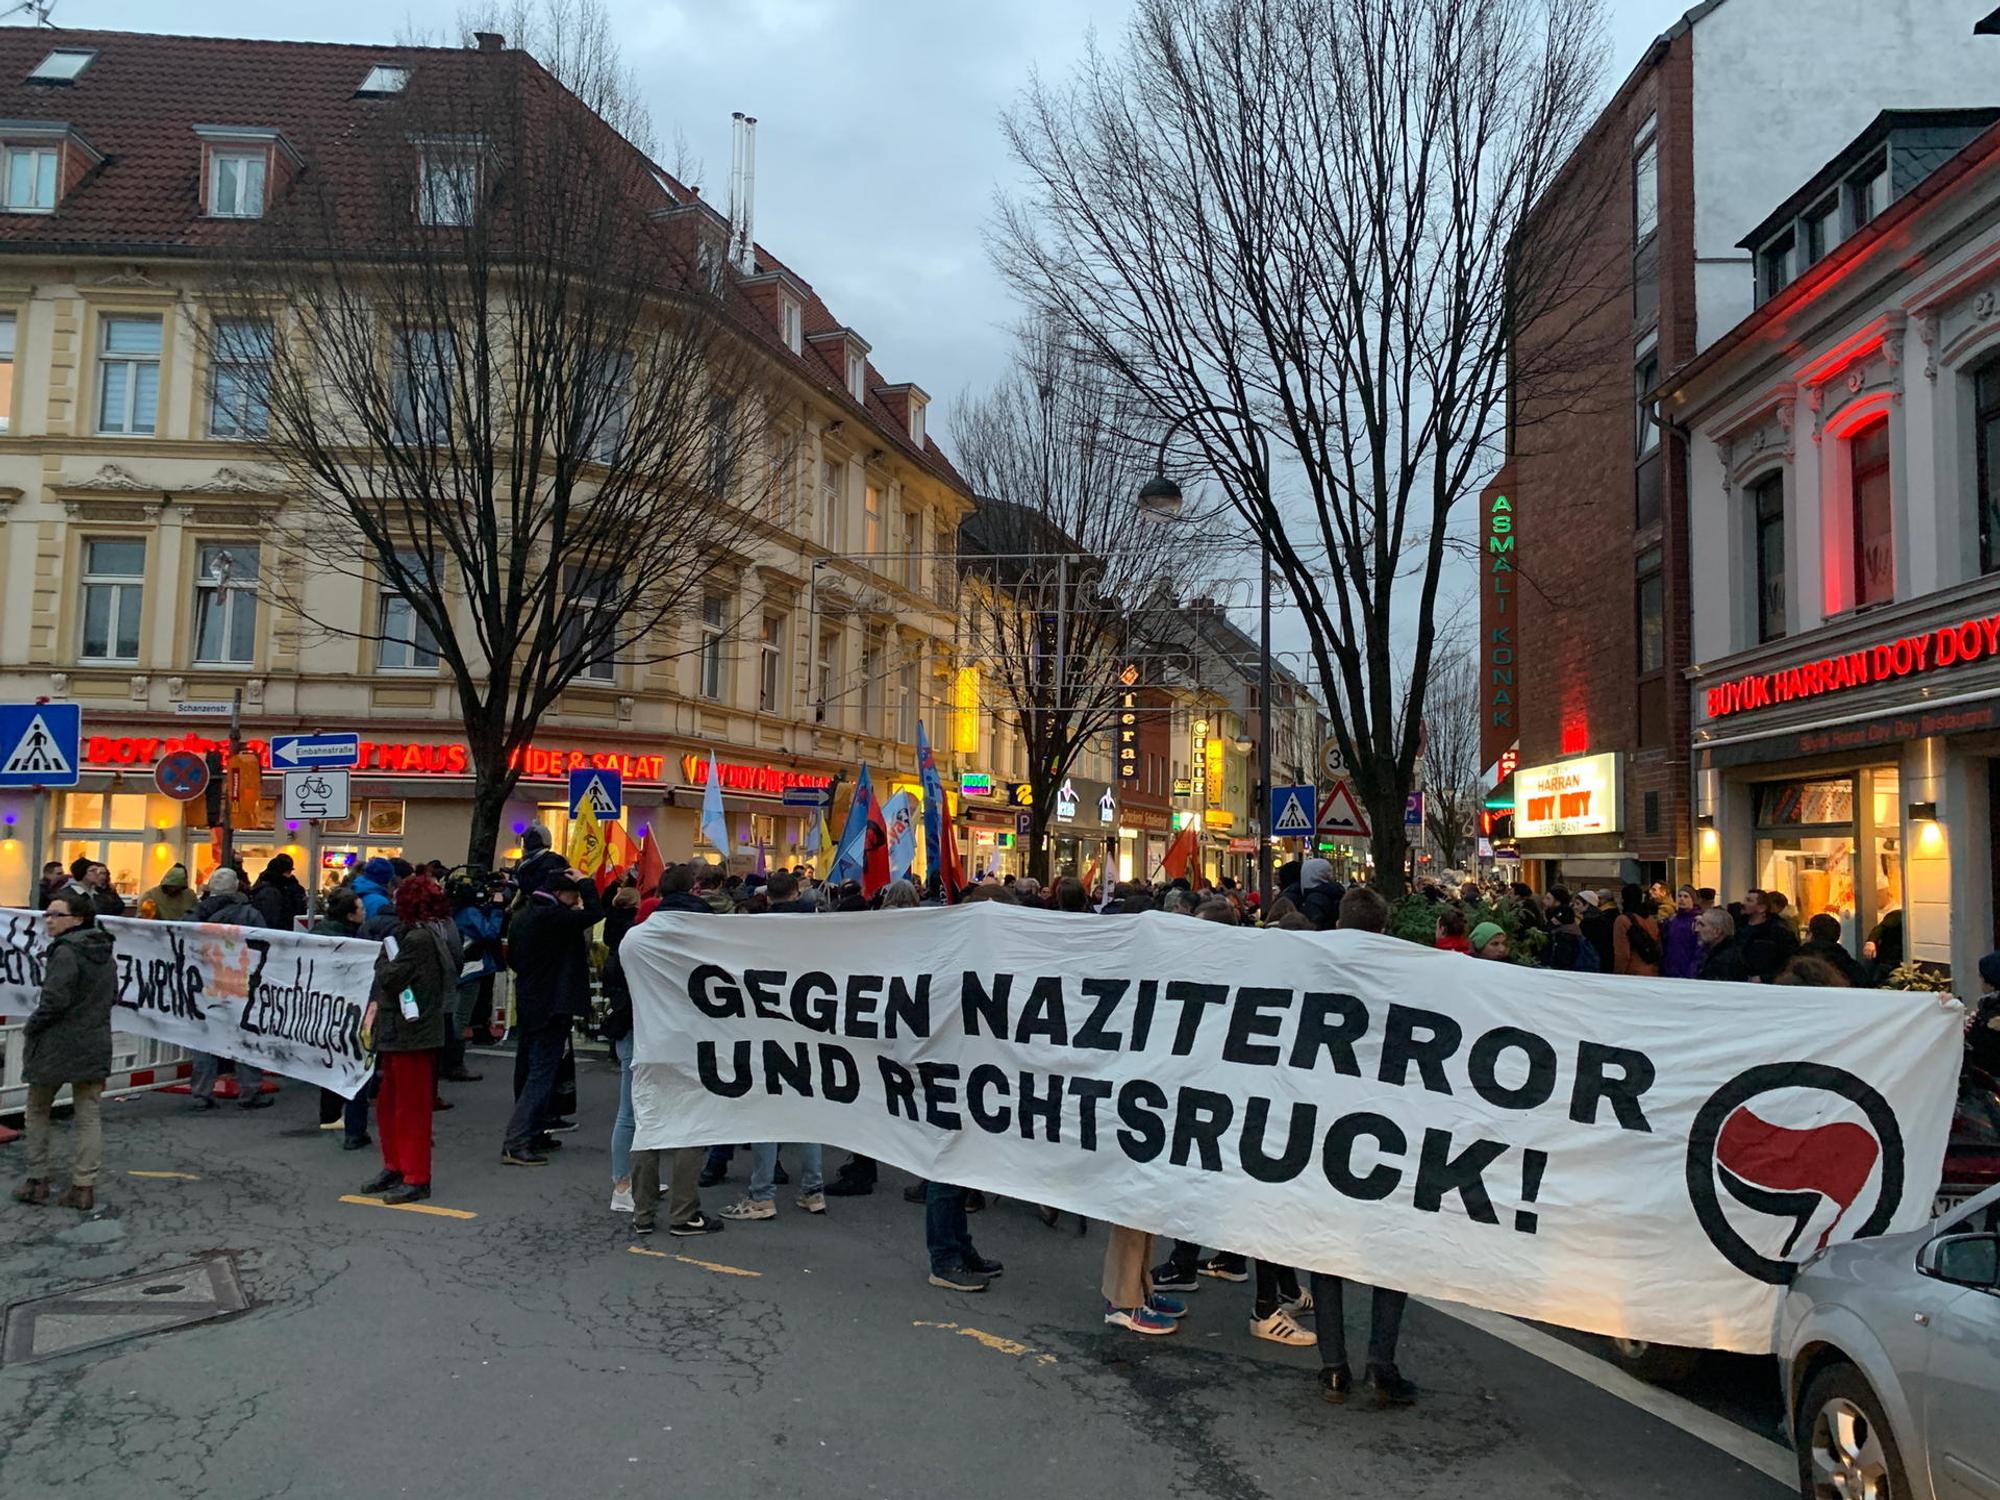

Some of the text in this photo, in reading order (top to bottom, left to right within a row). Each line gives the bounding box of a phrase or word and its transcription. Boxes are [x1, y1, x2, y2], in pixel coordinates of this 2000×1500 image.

[1490, 495, 1514, 614] ASMALI
[1492, 627, 1514, 728] KONAK
[1707, 612, 2000, 717] BÜYÜK HARRAN DOY DOY
[87, 735, 160, 764] DOY
[295, 746, 354, 756] Einbahnstraße
[379, 740, 467, 772] HAUS
[591, 752, 665, 781] SALAT
[696, 759, 728, 786] DY
[1537, 775, 1580, 793] HARRAN
[687, 963, 1656, 1134] GEGEN NAZITERROR
[696, 1040, 1549, 1236] UND RECHTSRUCK!
